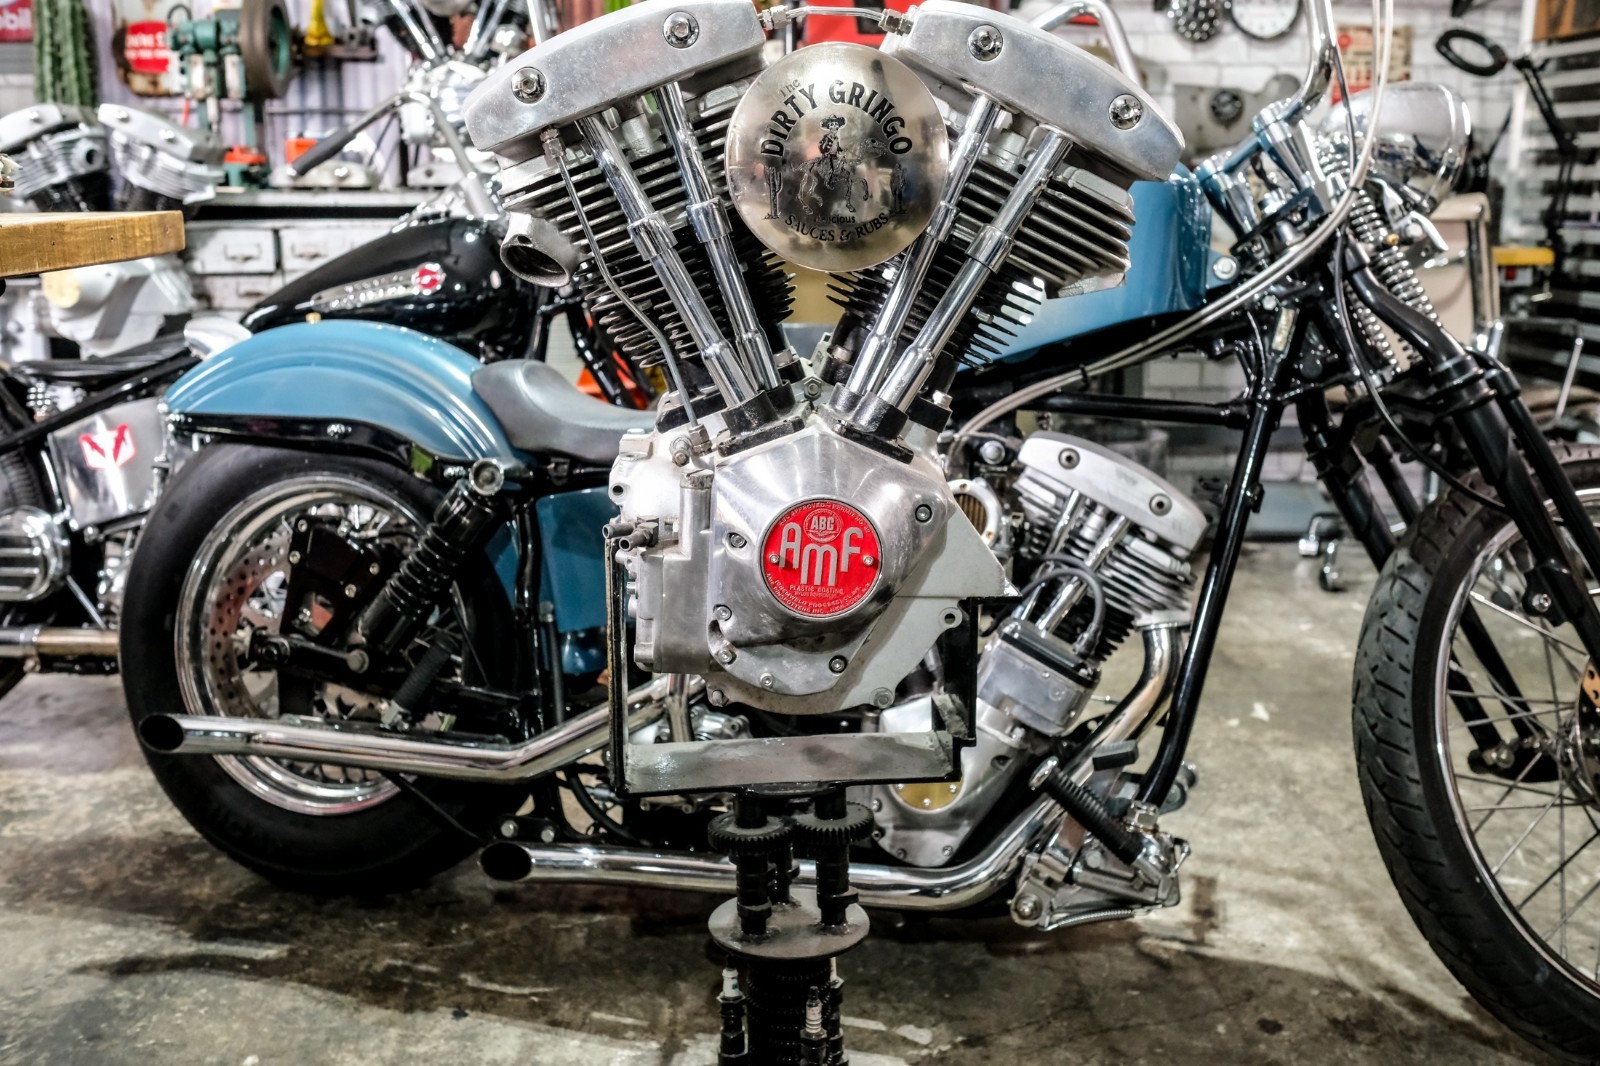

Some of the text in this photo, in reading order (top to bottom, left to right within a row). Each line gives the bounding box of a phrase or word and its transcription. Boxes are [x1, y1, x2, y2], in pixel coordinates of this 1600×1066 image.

[777, 77, 801, 99] The
[760, 79, 913, 157] DIRTY GRINGO
[785, 214, 835, 241] SAUCES
[854, 212, 889, 239] RUBS
[814, 214, 856, 225] icious
[810, 515, 835, 532] ABC
[789, 584, 815, 592] PLASTIC
[817, 587, 845, 595] COATING
